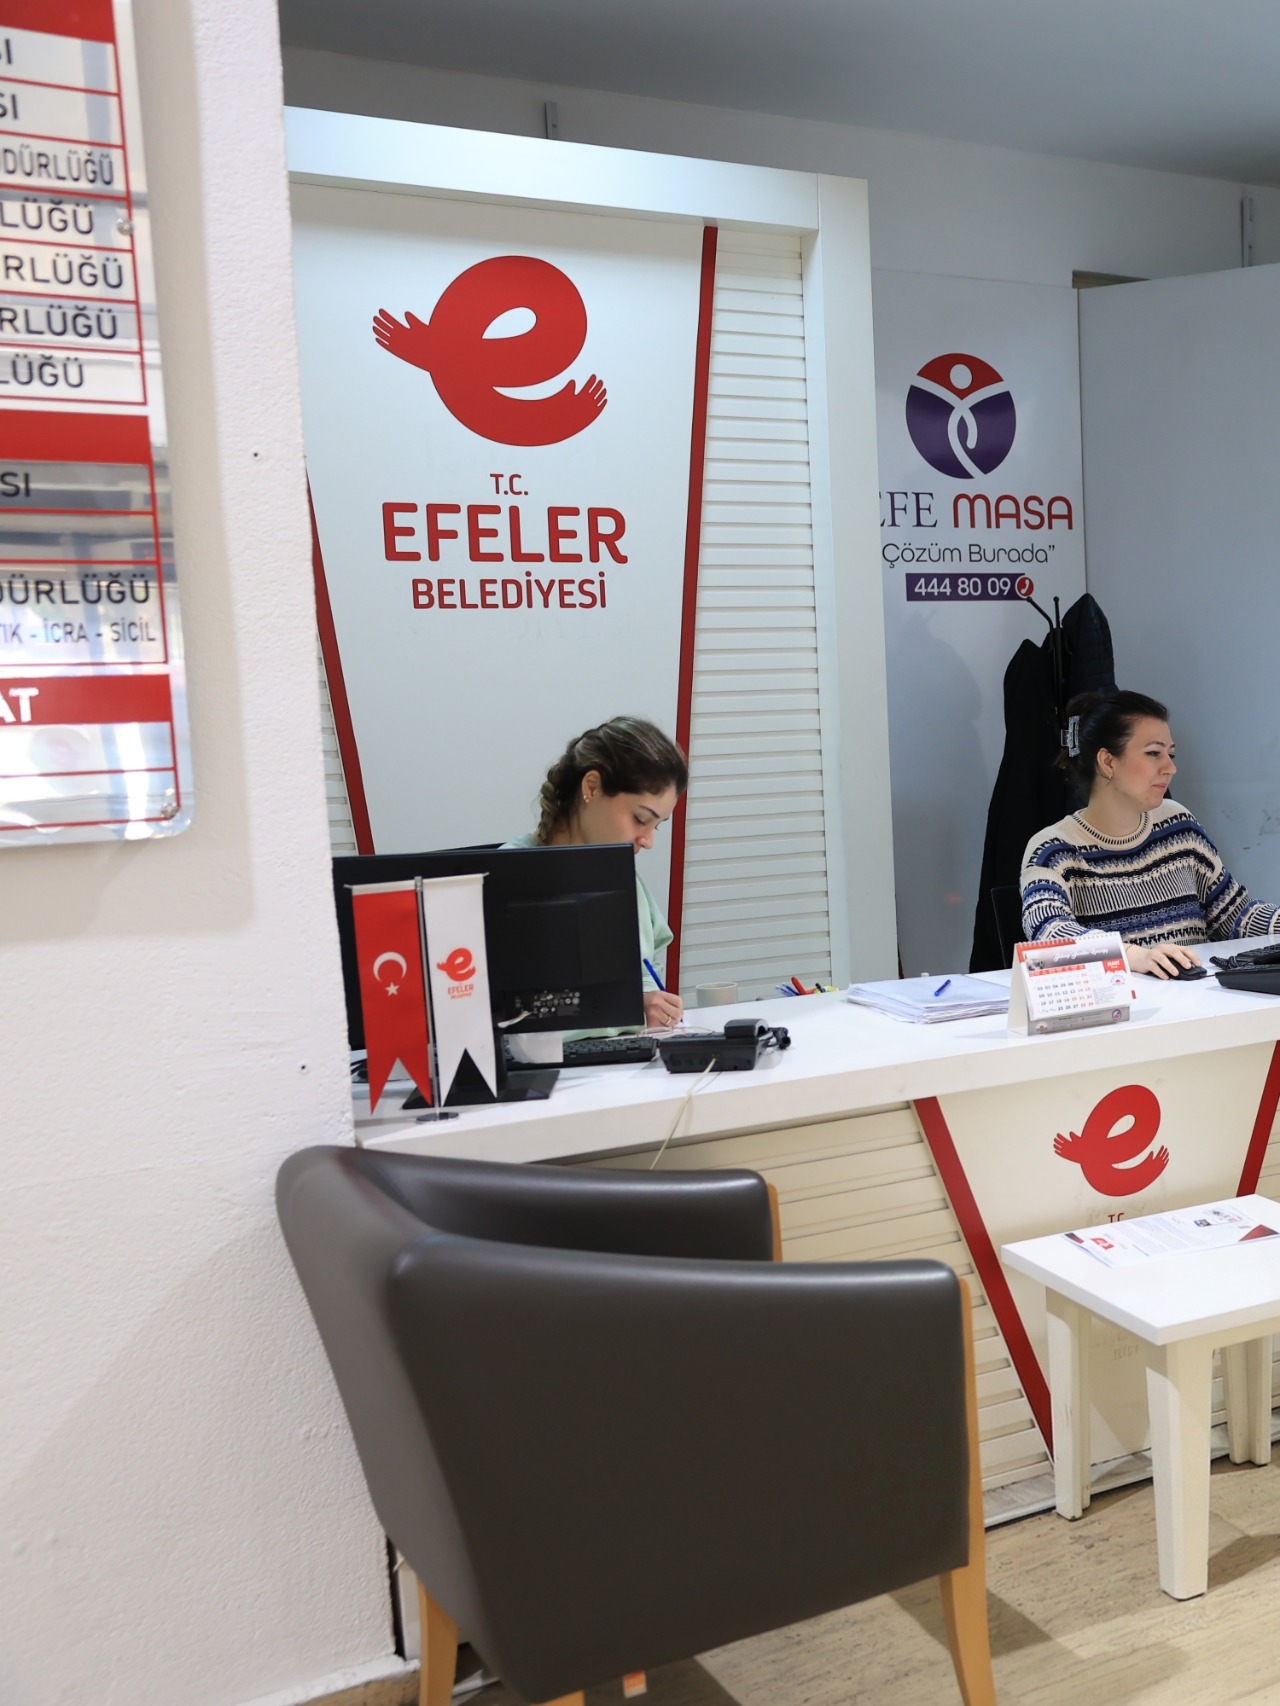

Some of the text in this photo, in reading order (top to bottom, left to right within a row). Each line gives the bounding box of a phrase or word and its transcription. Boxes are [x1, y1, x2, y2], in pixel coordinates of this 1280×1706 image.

[3, 143, 114, 186] DÜRLÜĞÜ
[0, 196, 94, 235] LÜĞÜ
[3, 252, 124, 290] RLÜĞÜ
[490, 473, 529, 496] T.C.
[879, 491, 938, 528] FE
[382, 502, 628, 564] EFELER
[882, 543, 962, 569] Çözüm
[0, 572, 150, 605] ÜRLÜĞÜ
[412, 570, 607, 609] BELEDİYESİ
[914, 577, 1012, 597] 444 80 09
[0, 622, 23, 644] IK
[43, 617, 90, 643] İCRA
[111, 616, 157, 643] SİCİL
